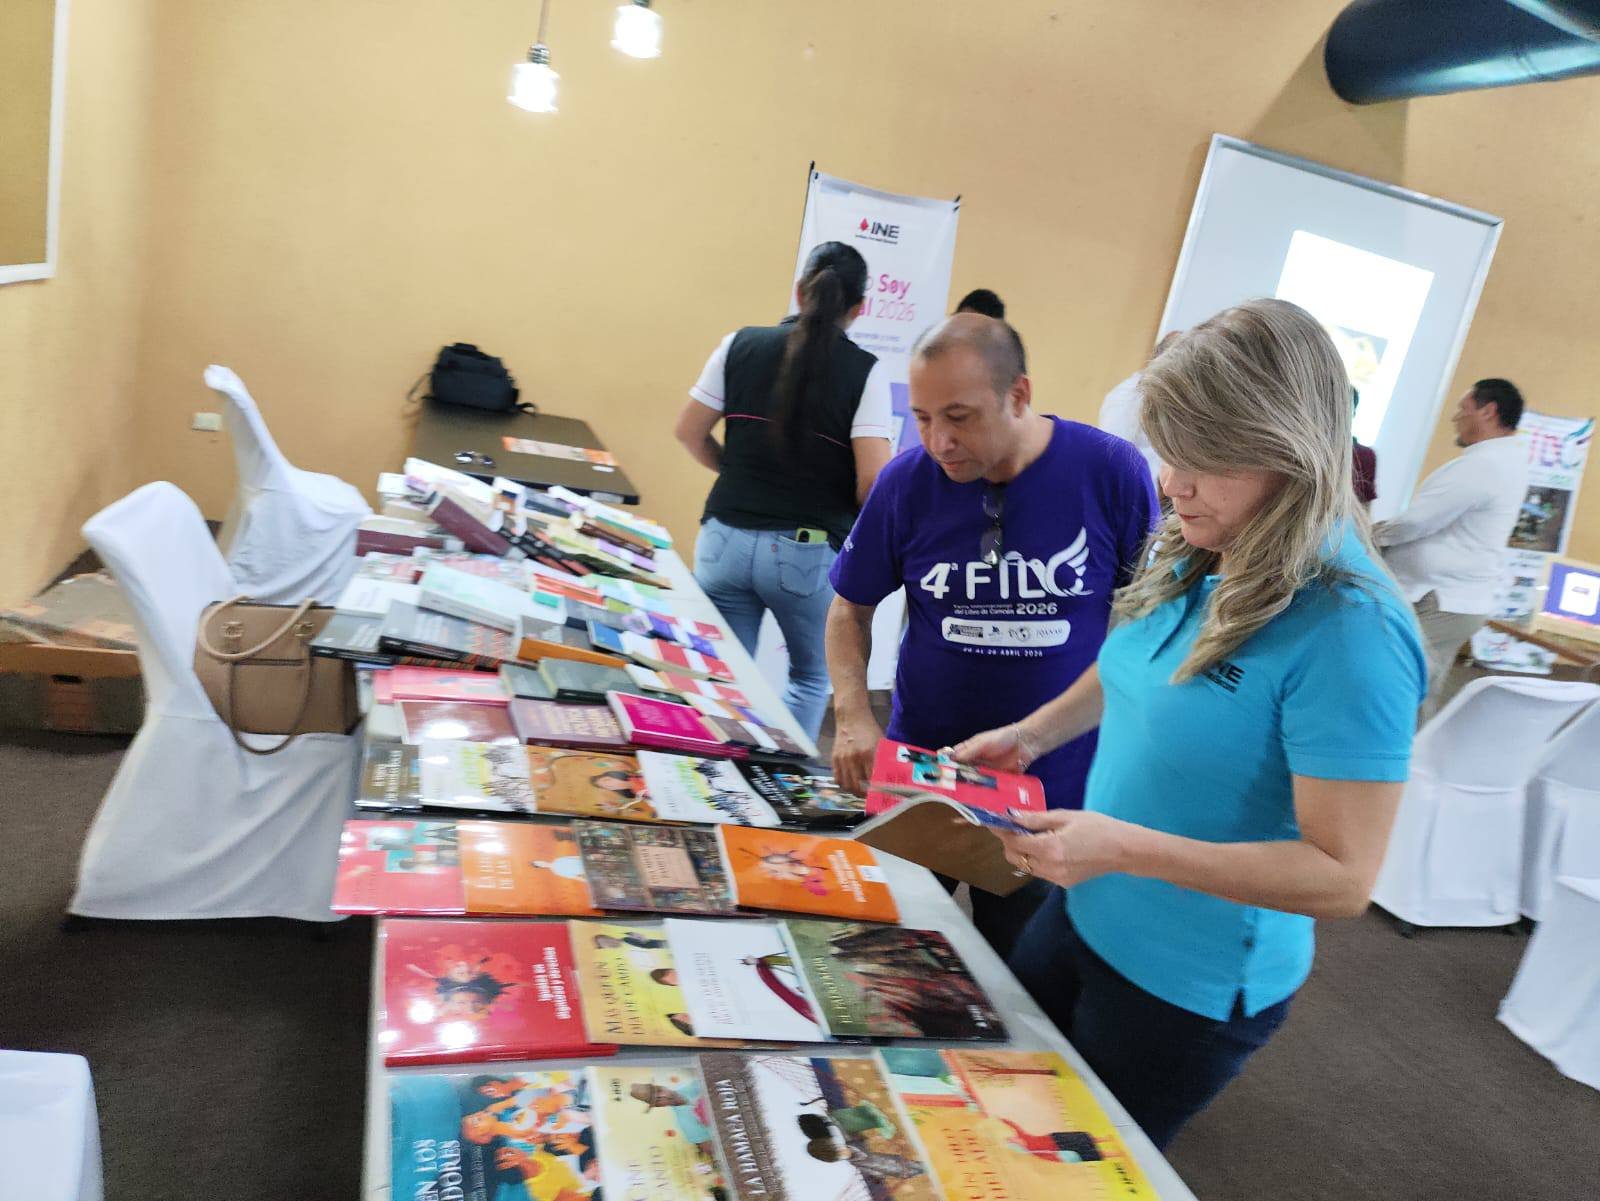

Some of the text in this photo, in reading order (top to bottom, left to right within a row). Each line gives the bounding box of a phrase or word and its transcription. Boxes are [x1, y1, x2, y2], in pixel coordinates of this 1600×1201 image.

[871, 221, 900, 239] INE
[878, 273, 911, 299] Soy
[876, 299, 916, 322] 2026
[1016, 602, 1058, 615] 2026
[1000, 649, 1021, 657] ABRIL
[714, 1078, 740, 1110] ROJA
[412, 1138, 438, 1173] LOS
[725, 1113, 758, 1174] HAMACA
[437, 1139, 464, 1201] DORES
[747, 1177, 767, 1196] LA
